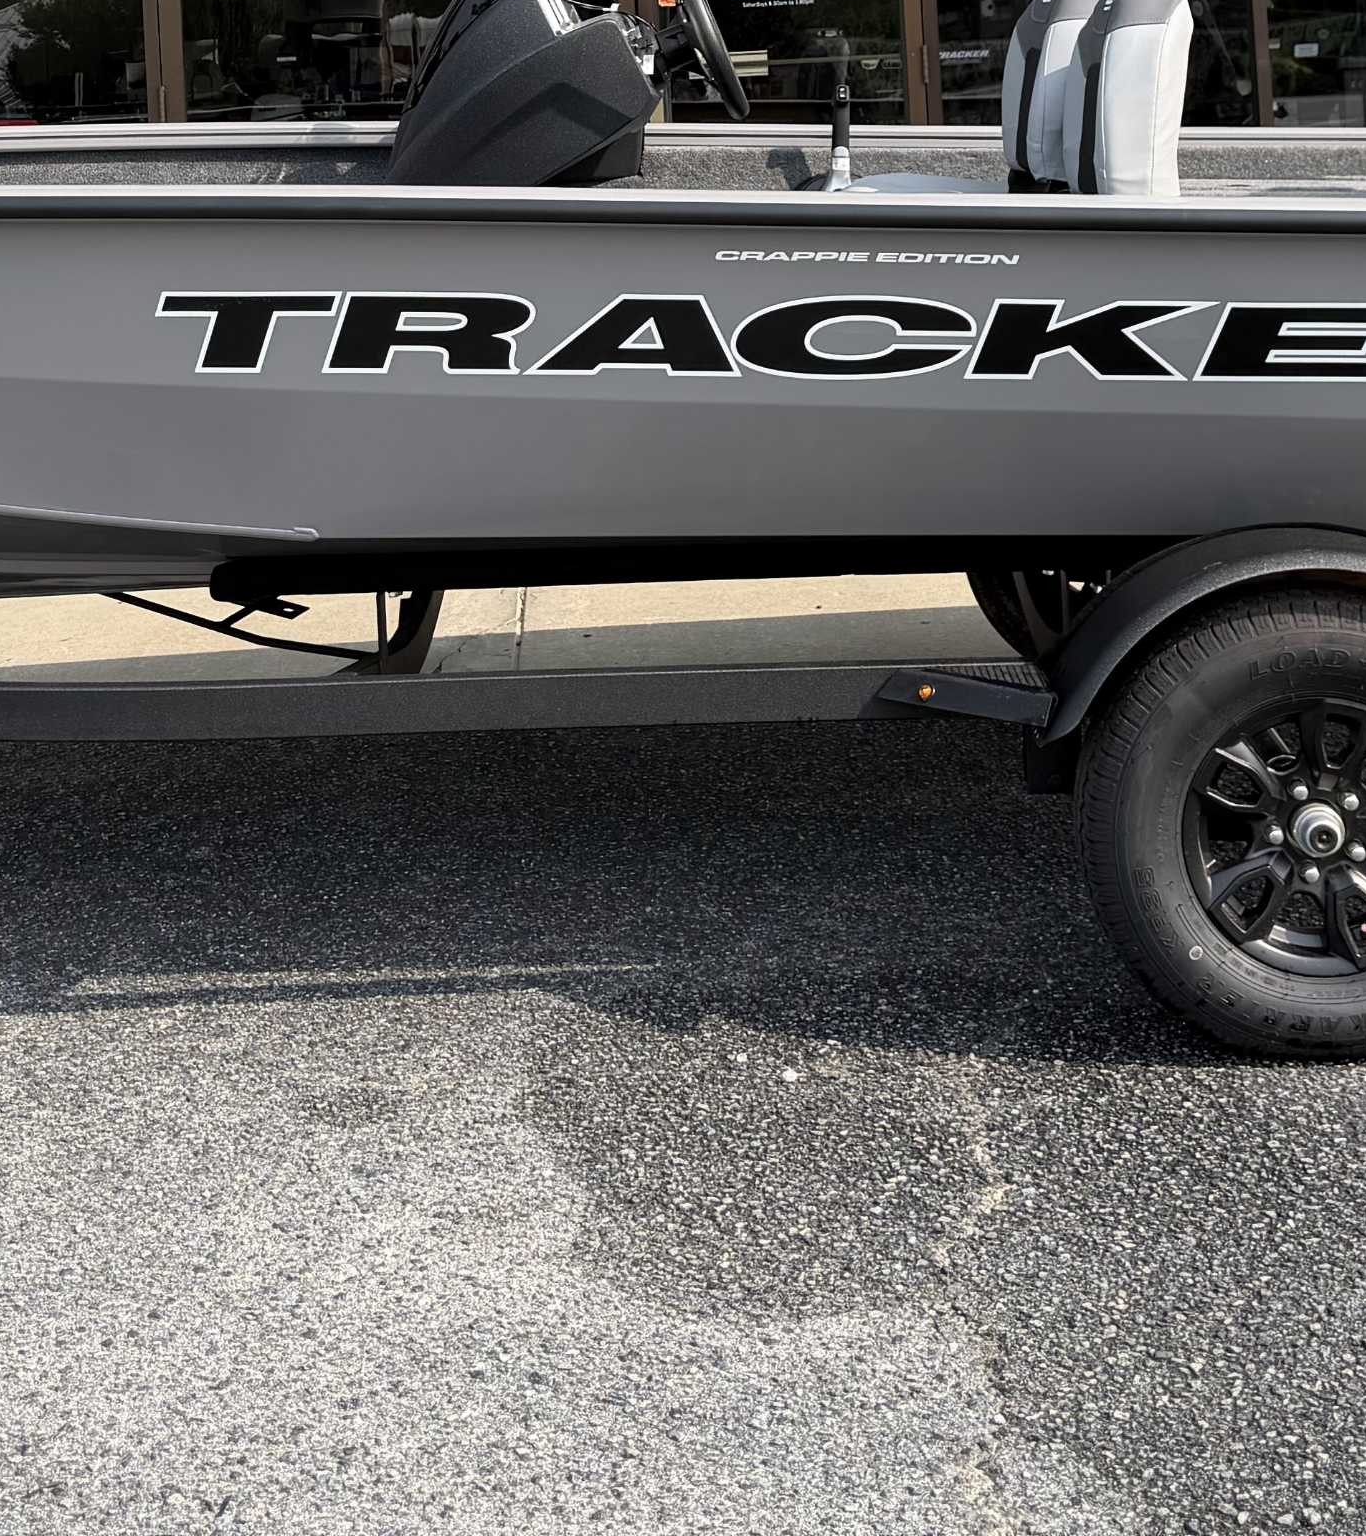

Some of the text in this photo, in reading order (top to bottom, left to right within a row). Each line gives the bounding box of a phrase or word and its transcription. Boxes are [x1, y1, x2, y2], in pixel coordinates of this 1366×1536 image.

[715, 249, 1020, 265] CRAPPIE EDITION
[1248, 647, 1352, 681] LOAD
